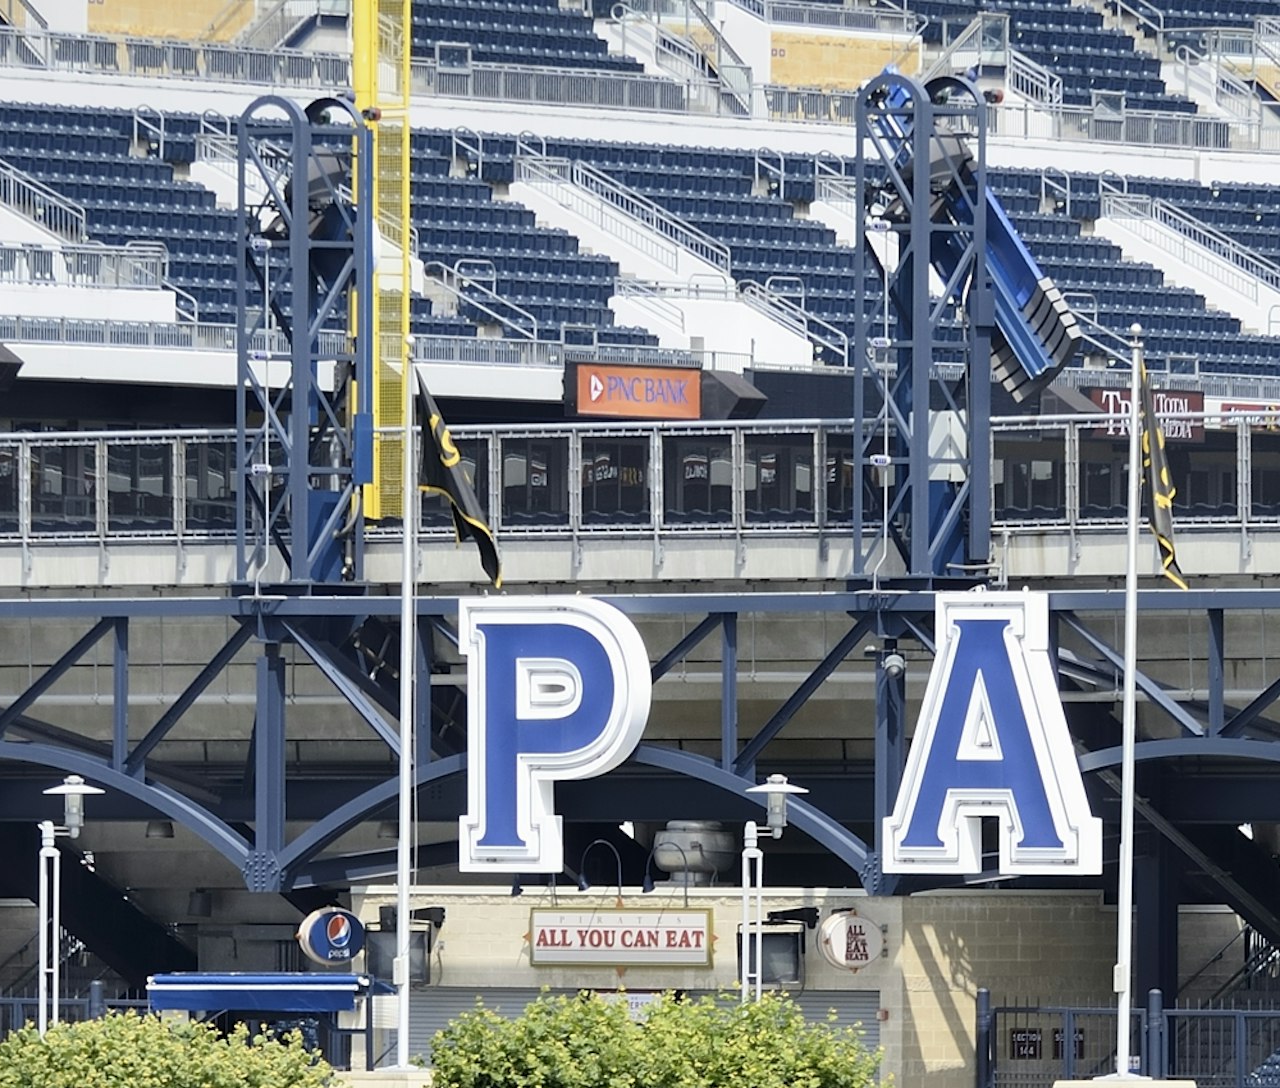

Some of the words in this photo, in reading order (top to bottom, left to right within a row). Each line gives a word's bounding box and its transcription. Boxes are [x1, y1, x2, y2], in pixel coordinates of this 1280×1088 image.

[607, 375, 642, 402] PNC
[644, 378, 689, 404] BANK
[847, 924, 866, 936] ALL
[536, 929, 572, 947] ALL
[577, 929, 616, 948] YOU
[620, 930, 659, 948] CAN
[665, 930, 705, 948] EAT
[846, 942, 868, 953] EAT
